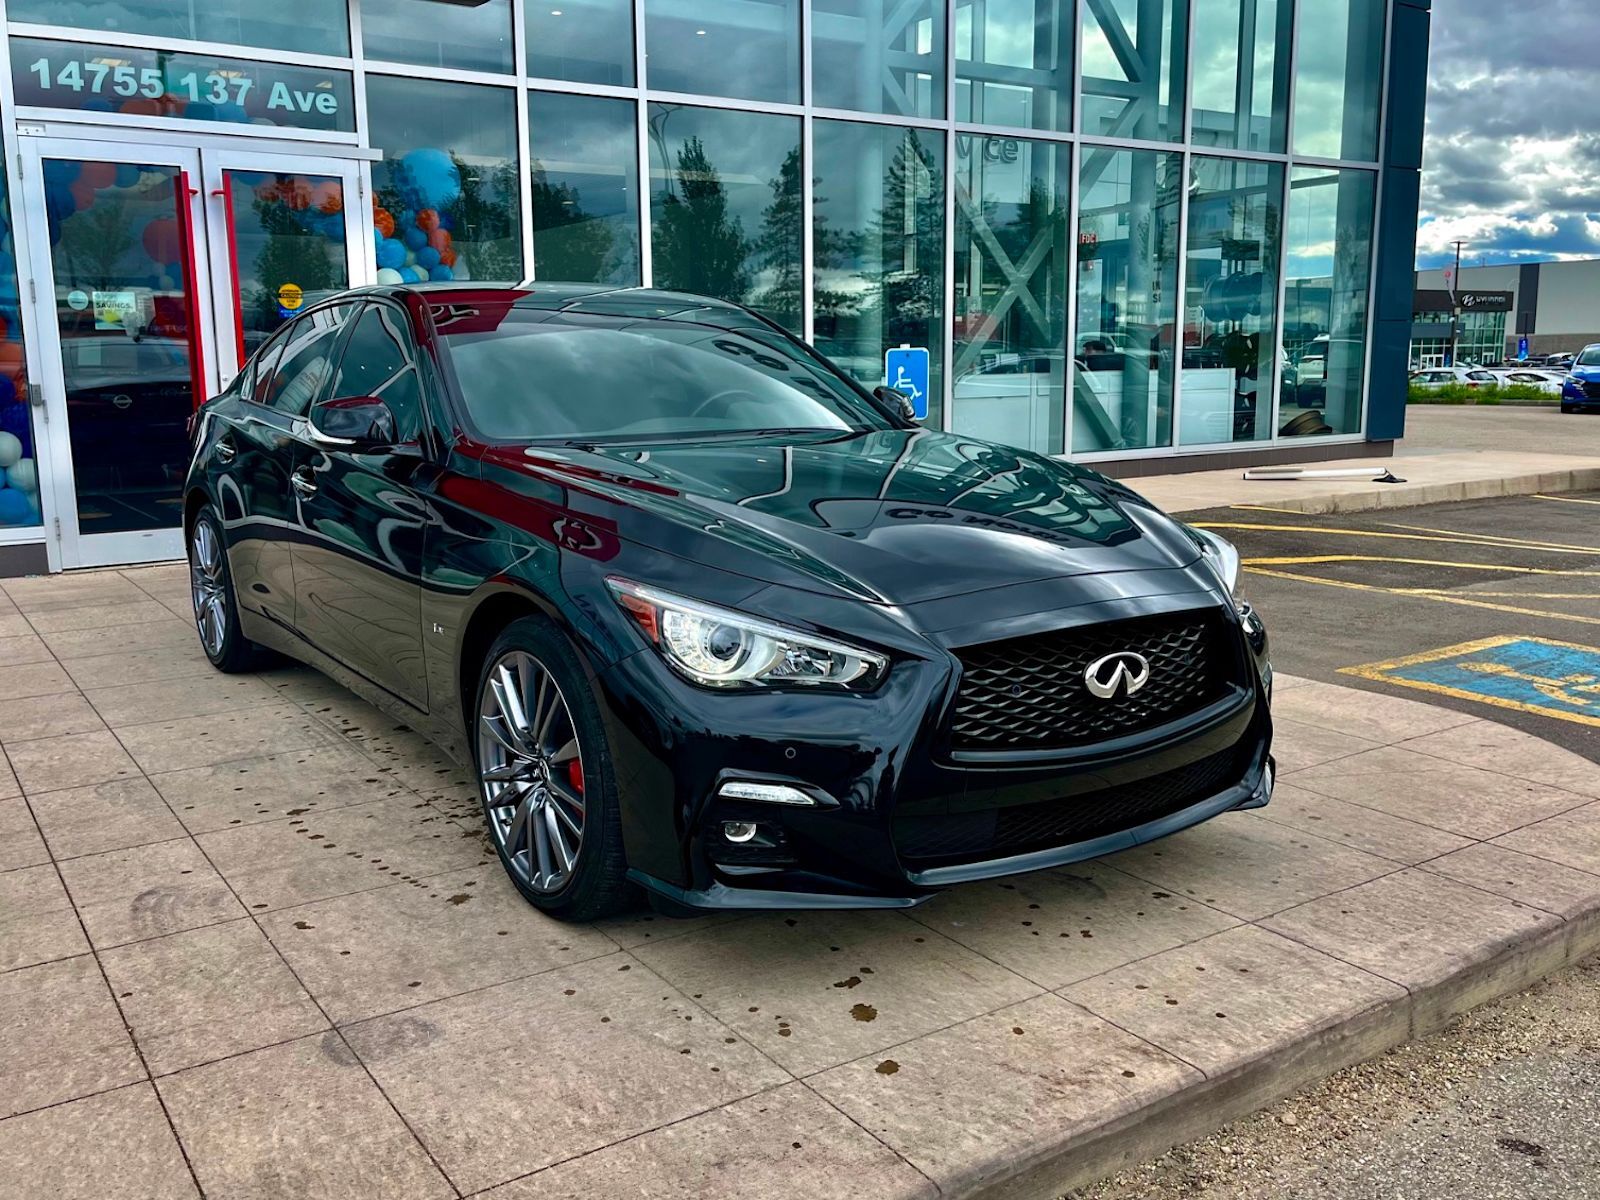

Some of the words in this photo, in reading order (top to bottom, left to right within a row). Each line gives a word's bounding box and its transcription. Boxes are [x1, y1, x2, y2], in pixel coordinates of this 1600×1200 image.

[29, 58, 164, 99] 14755
[179, 72, 252, 107] 137
[266, 81, 338, 115] Ave
